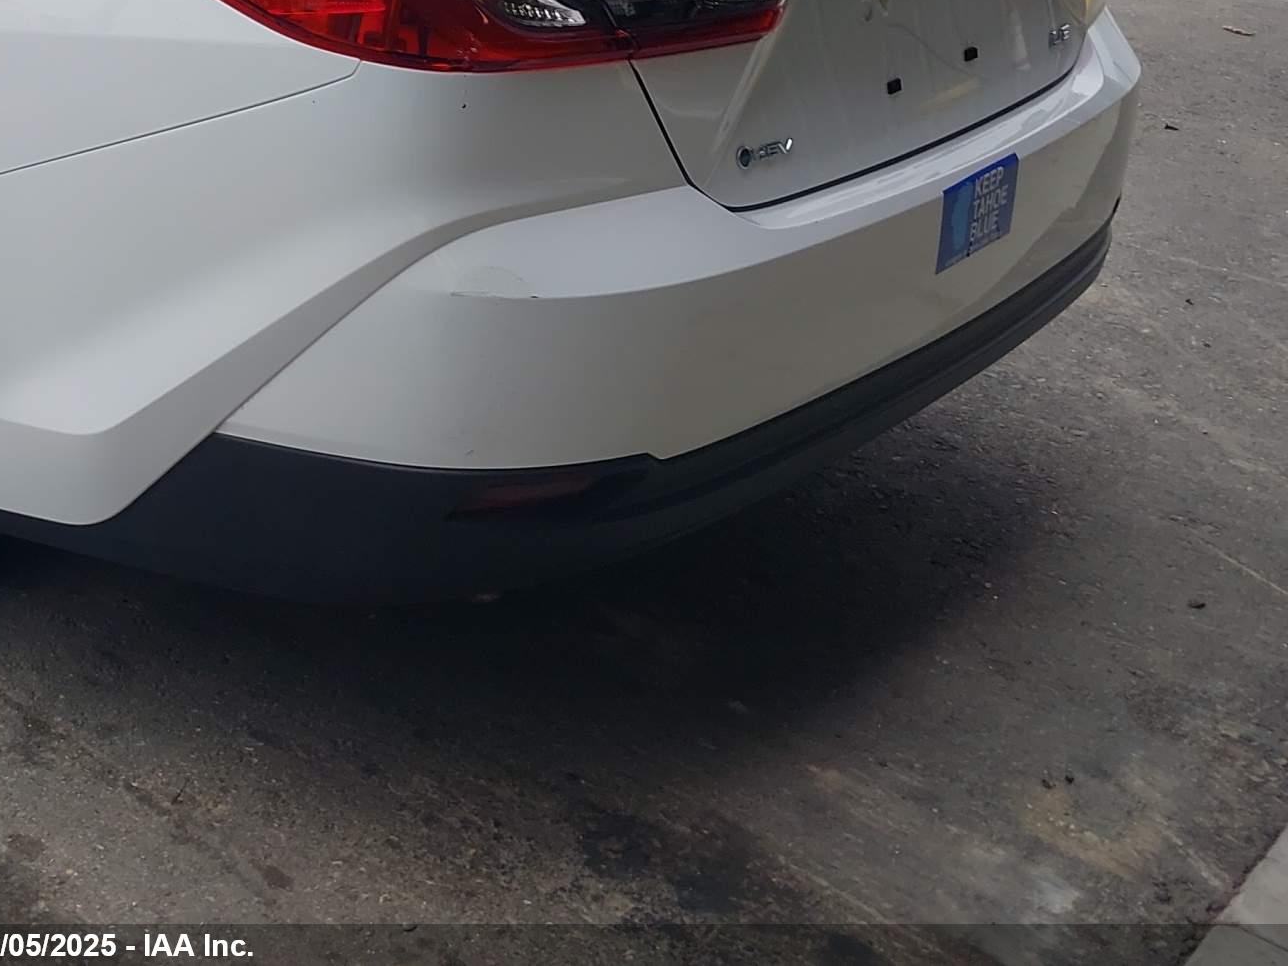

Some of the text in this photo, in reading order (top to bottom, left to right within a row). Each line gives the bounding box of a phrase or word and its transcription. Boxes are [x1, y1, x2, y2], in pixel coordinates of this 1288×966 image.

[974, 165, 1004, 198] KEEP
[972, 184, 1009, 220] TAHOE
[969, 209, 1000, 242] BLUE
